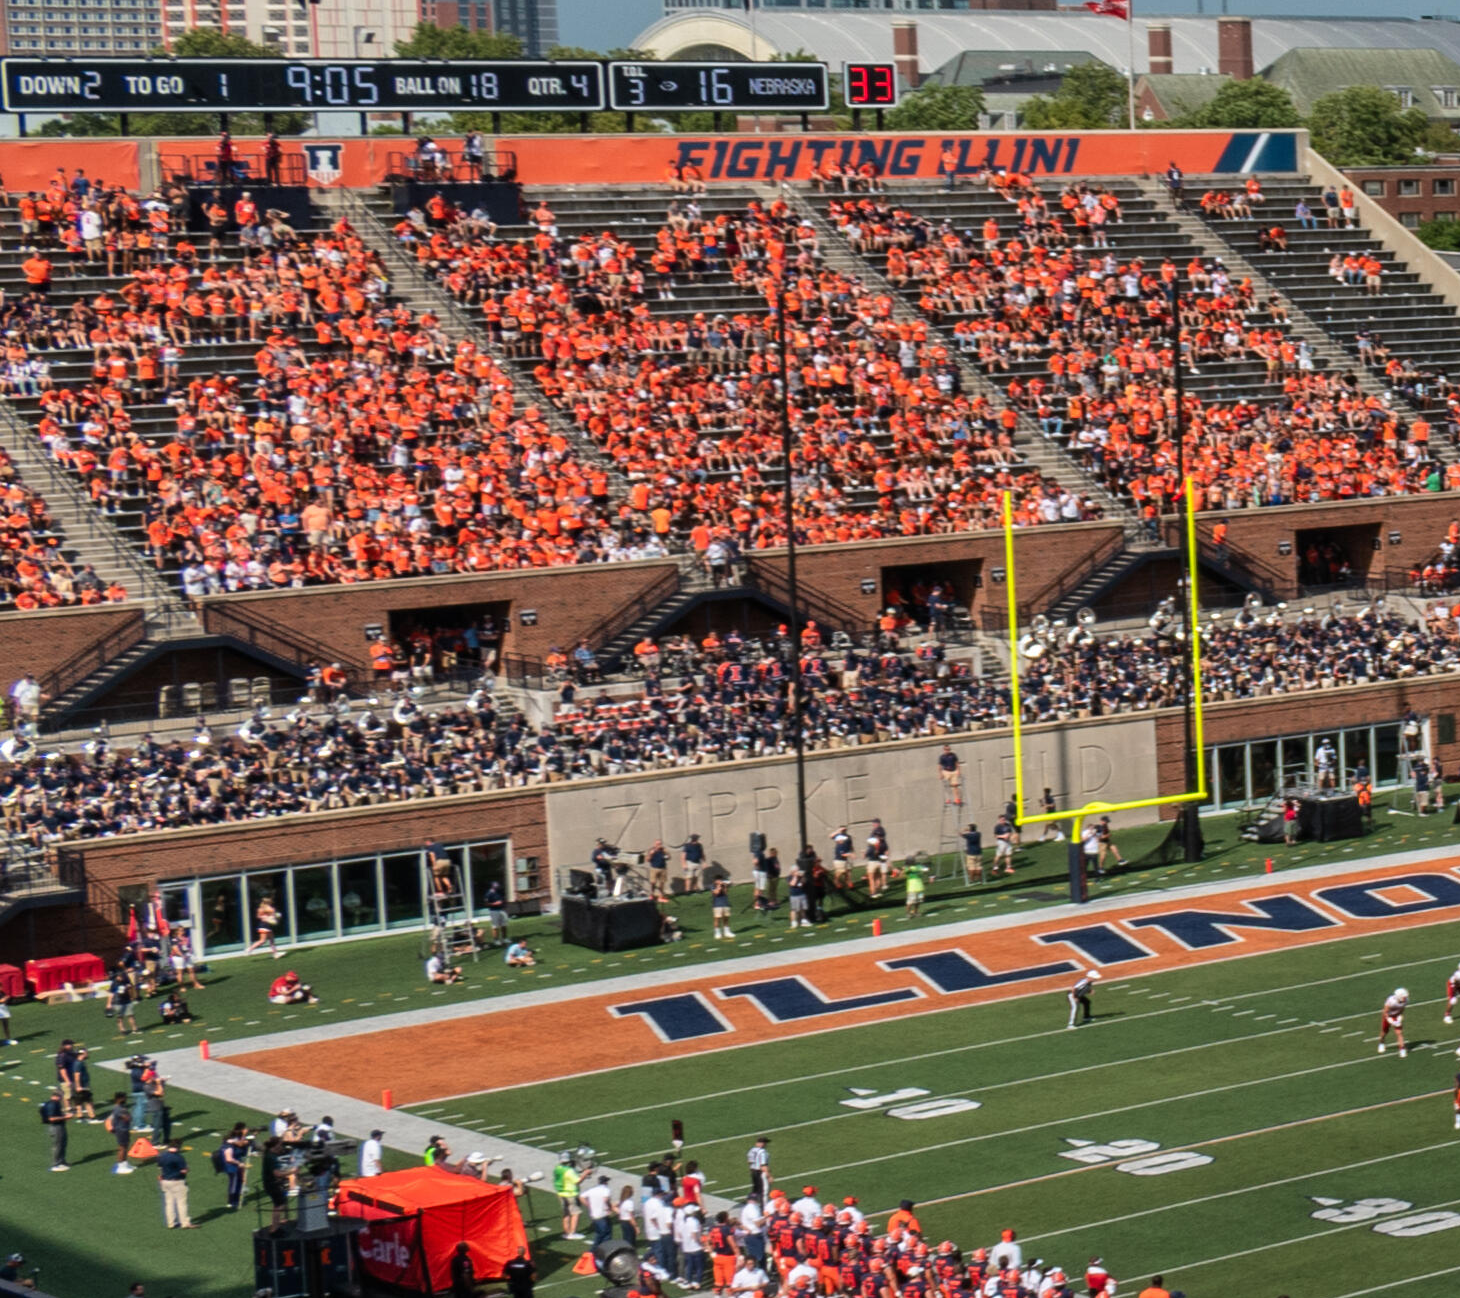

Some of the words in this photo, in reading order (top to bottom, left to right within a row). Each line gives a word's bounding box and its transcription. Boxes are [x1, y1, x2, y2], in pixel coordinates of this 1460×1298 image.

[18, 76, 80, 94] DOWN
[82, 71, 101, 99] 2
[125, 76, 151, 94] TO
[156, 76, 184, 94] GO
[219, 73, 228, 97] 1
[287, 67, 378, 103] 9:05
[394, 77, 435, 94] BALL
[438, 76, 461, 94] ON
[470, 73, 498, 99] 18
[527, 77, 566, 95] QTR.
[571, 75, 588, 97] 4
[629, 79, 645, 104] 3
[700, 69, 733, 103] 16
[749, 78, 816, 95] NEBRASKA
[850, 67, 892, 102] 33
[676, 139, 925, 179] FIGHTING
[937, 138, 1081, 175] ILLINI
[602, 771, 884, 852] ZUPPKE
[838, 1087, 982, 1122] 10
[1058, 1138, 1216, 1176] 20
[359, 1226, 410, 1269] Carle
